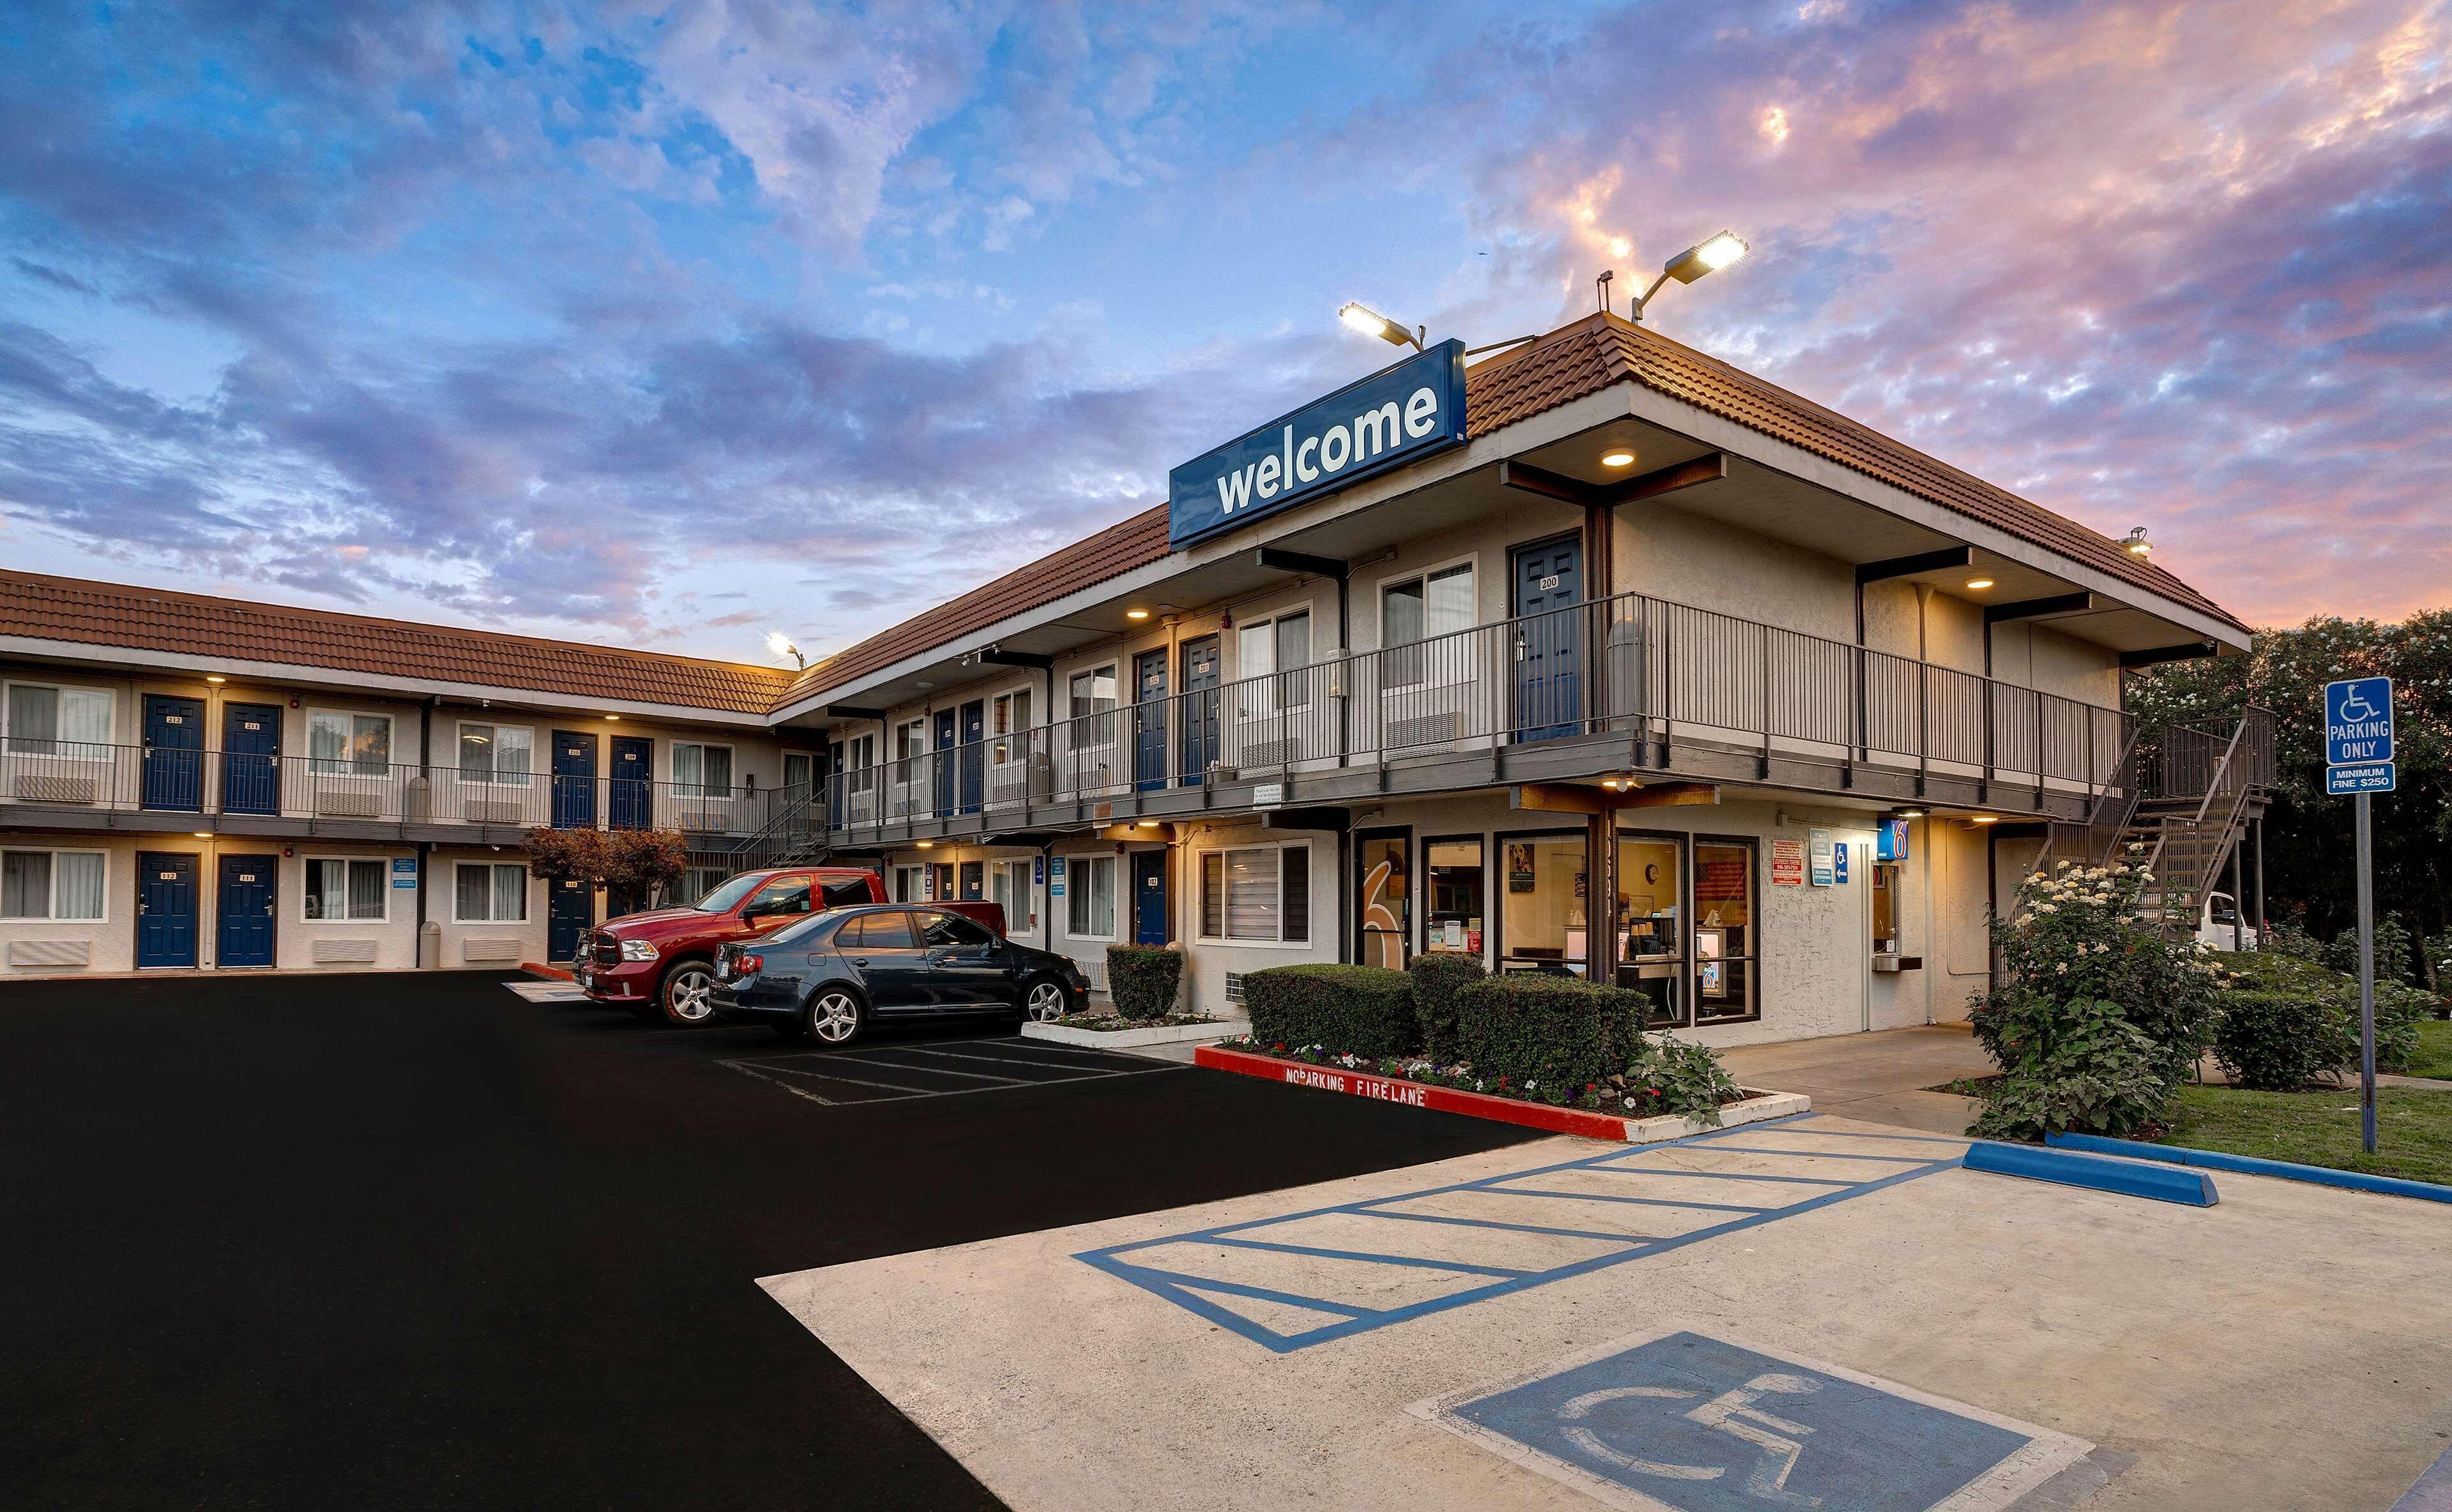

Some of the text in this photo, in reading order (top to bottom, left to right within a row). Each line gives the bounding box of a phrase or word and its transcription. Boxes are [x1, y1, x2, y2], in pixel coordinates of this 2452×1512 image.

[1217, 386, 1438, 515] welcome
[1542, 577, 1556, 589] 200
[2331, 720, 2389, 741] PARKING
[2342, 741, 2376, 759] ONLY
[2336, 767, 2384, 779] MINIMUM
[2360, 777, 2389, 787] $250
[1894, 822, 1906, 858] 6
[1704, 971, 1714, 987] 6
[1286, 1068, 1426, 1107] NO PARKING FIRE LANE
